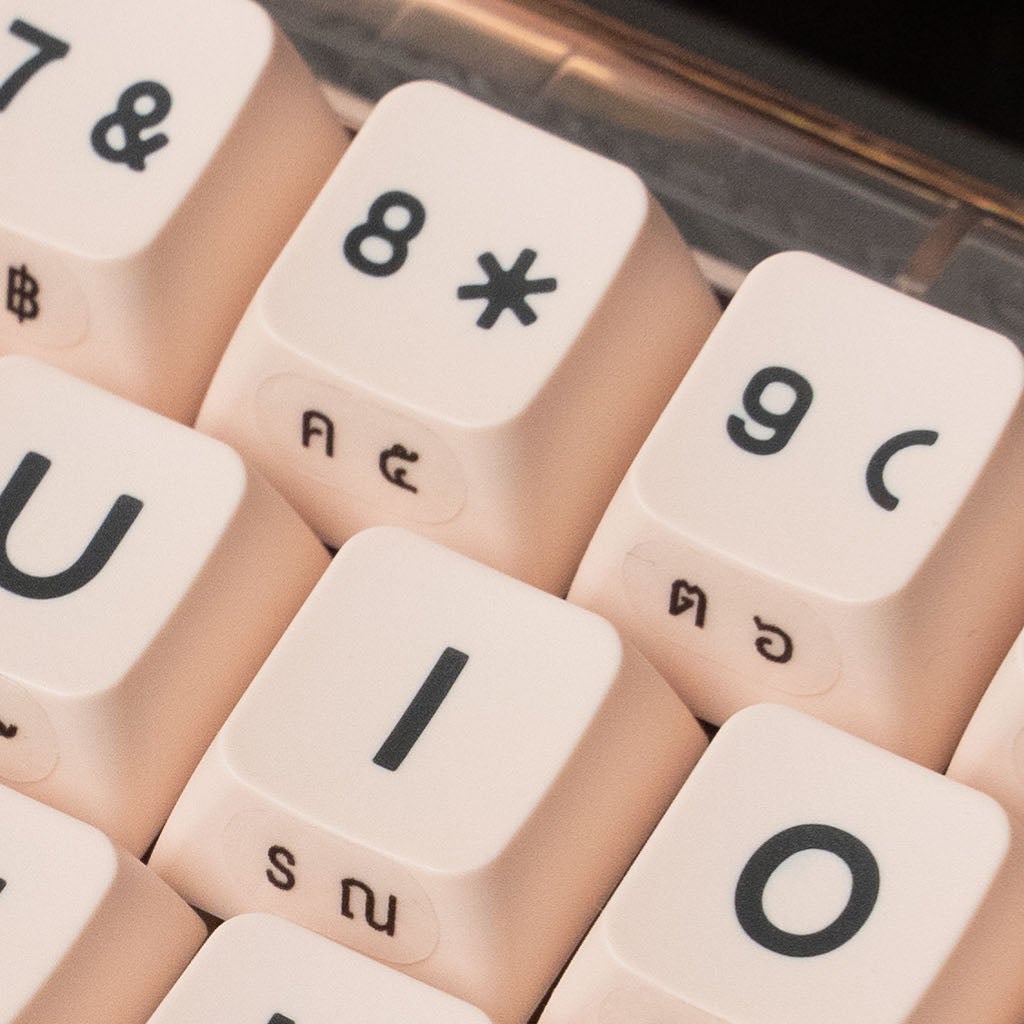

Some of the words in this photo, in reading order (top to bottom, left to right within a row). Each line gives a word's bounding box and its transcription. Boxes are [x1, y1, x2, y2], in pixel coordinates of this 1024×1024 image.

[88, 78, 174, 174] &
[341, 189, 428, 279] 8
[724, 364, 815, 457] 9
[370, 645, 471, 773] I
[732, 822, 882, 960] O
